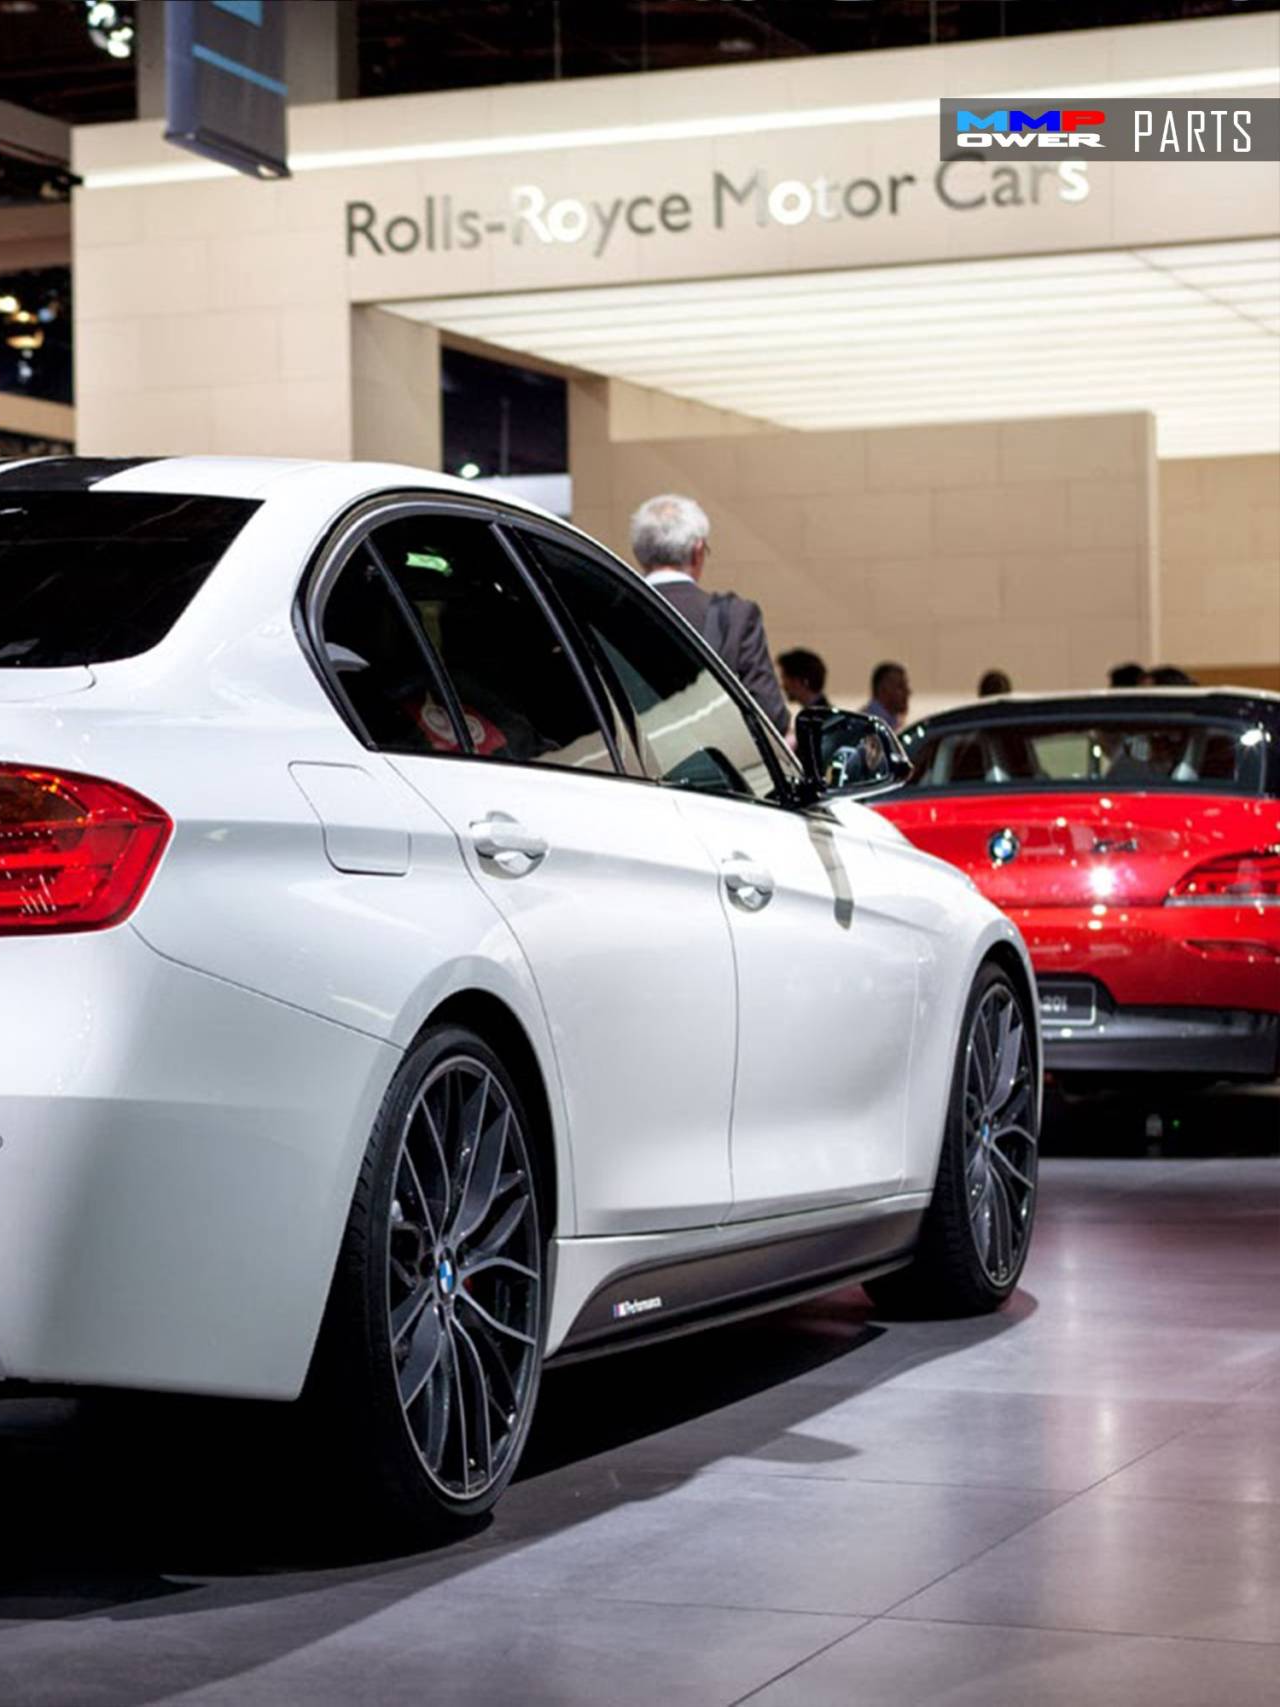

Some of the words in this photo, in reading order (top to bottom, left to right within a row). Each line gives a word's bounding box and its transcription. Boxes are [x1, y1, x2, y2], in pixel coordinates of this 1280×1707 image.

[345, 184, 692, 258] Rolls-Royce
[712, 167, 917, 229] Motor
[933, 150, 1090, 210] Cars
